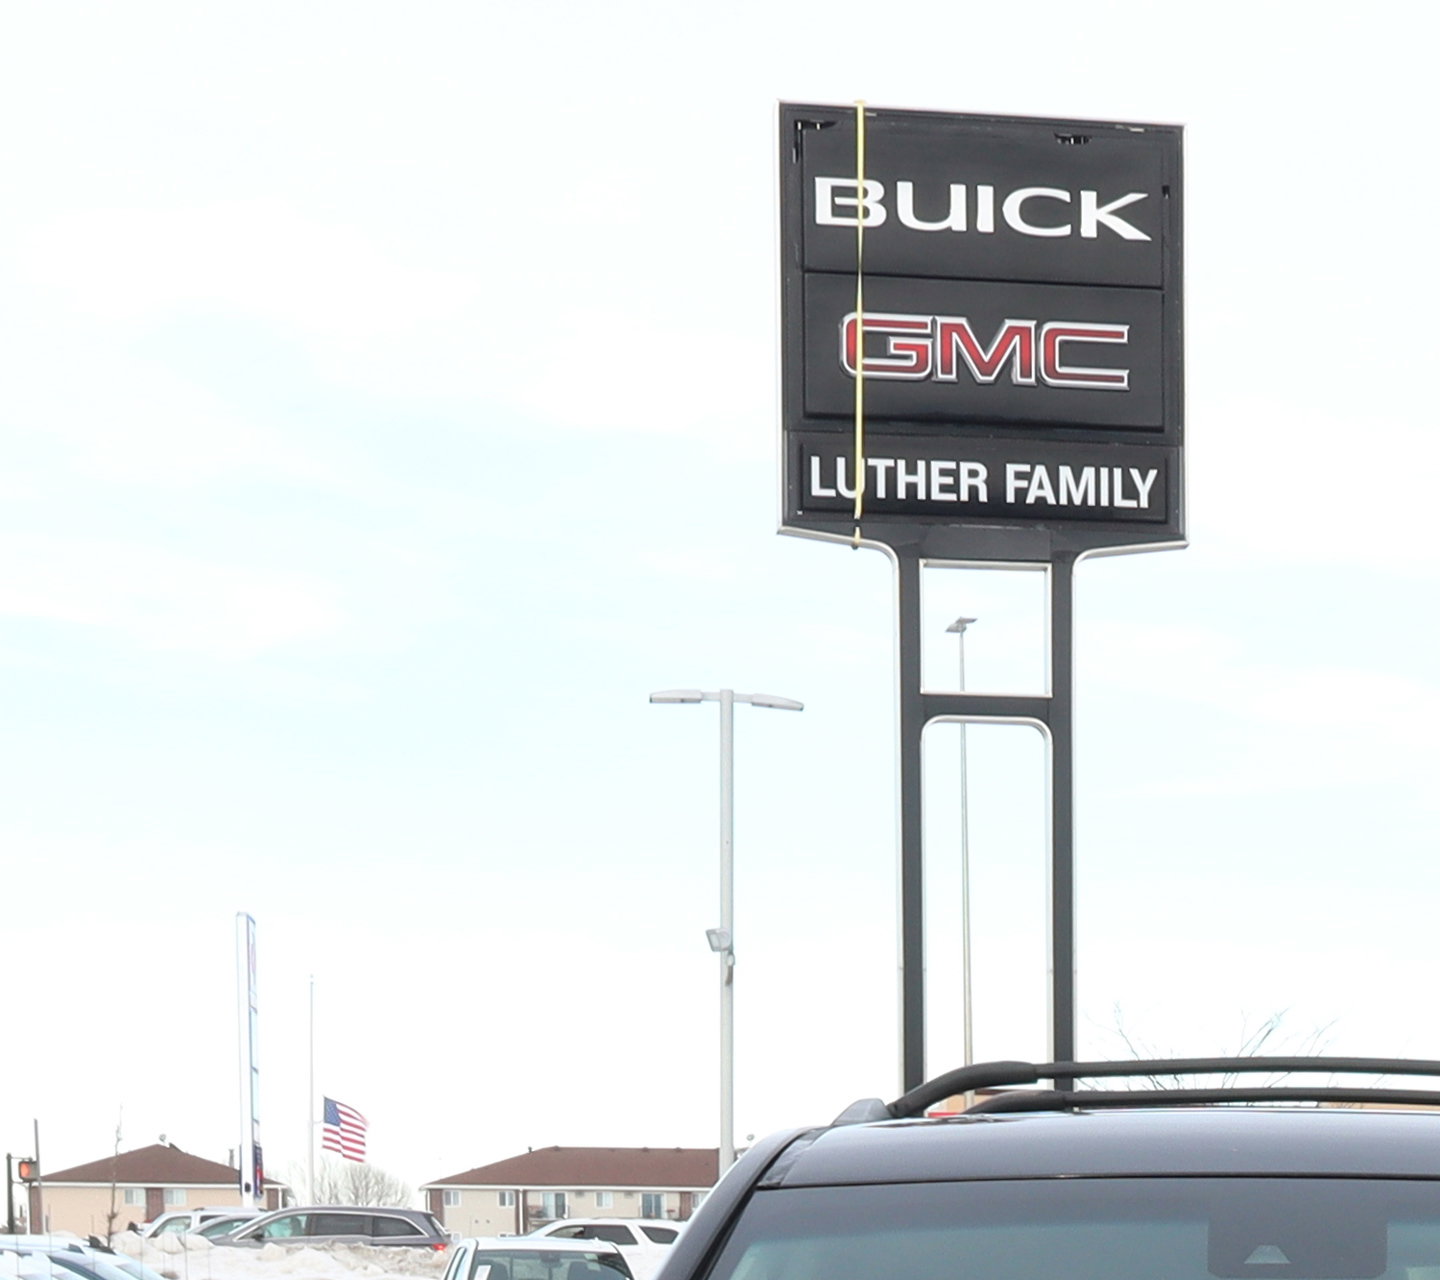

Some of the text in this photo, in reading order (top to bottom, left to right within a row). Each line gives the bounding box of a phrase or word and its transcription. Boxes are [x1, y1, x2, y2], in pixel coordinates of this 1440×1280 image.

[814, 176, 1152, 241] BUICK
[839, 311, 1130, 391] GMC
[810, 455, 1158, 508] LUTHER FAMILY
